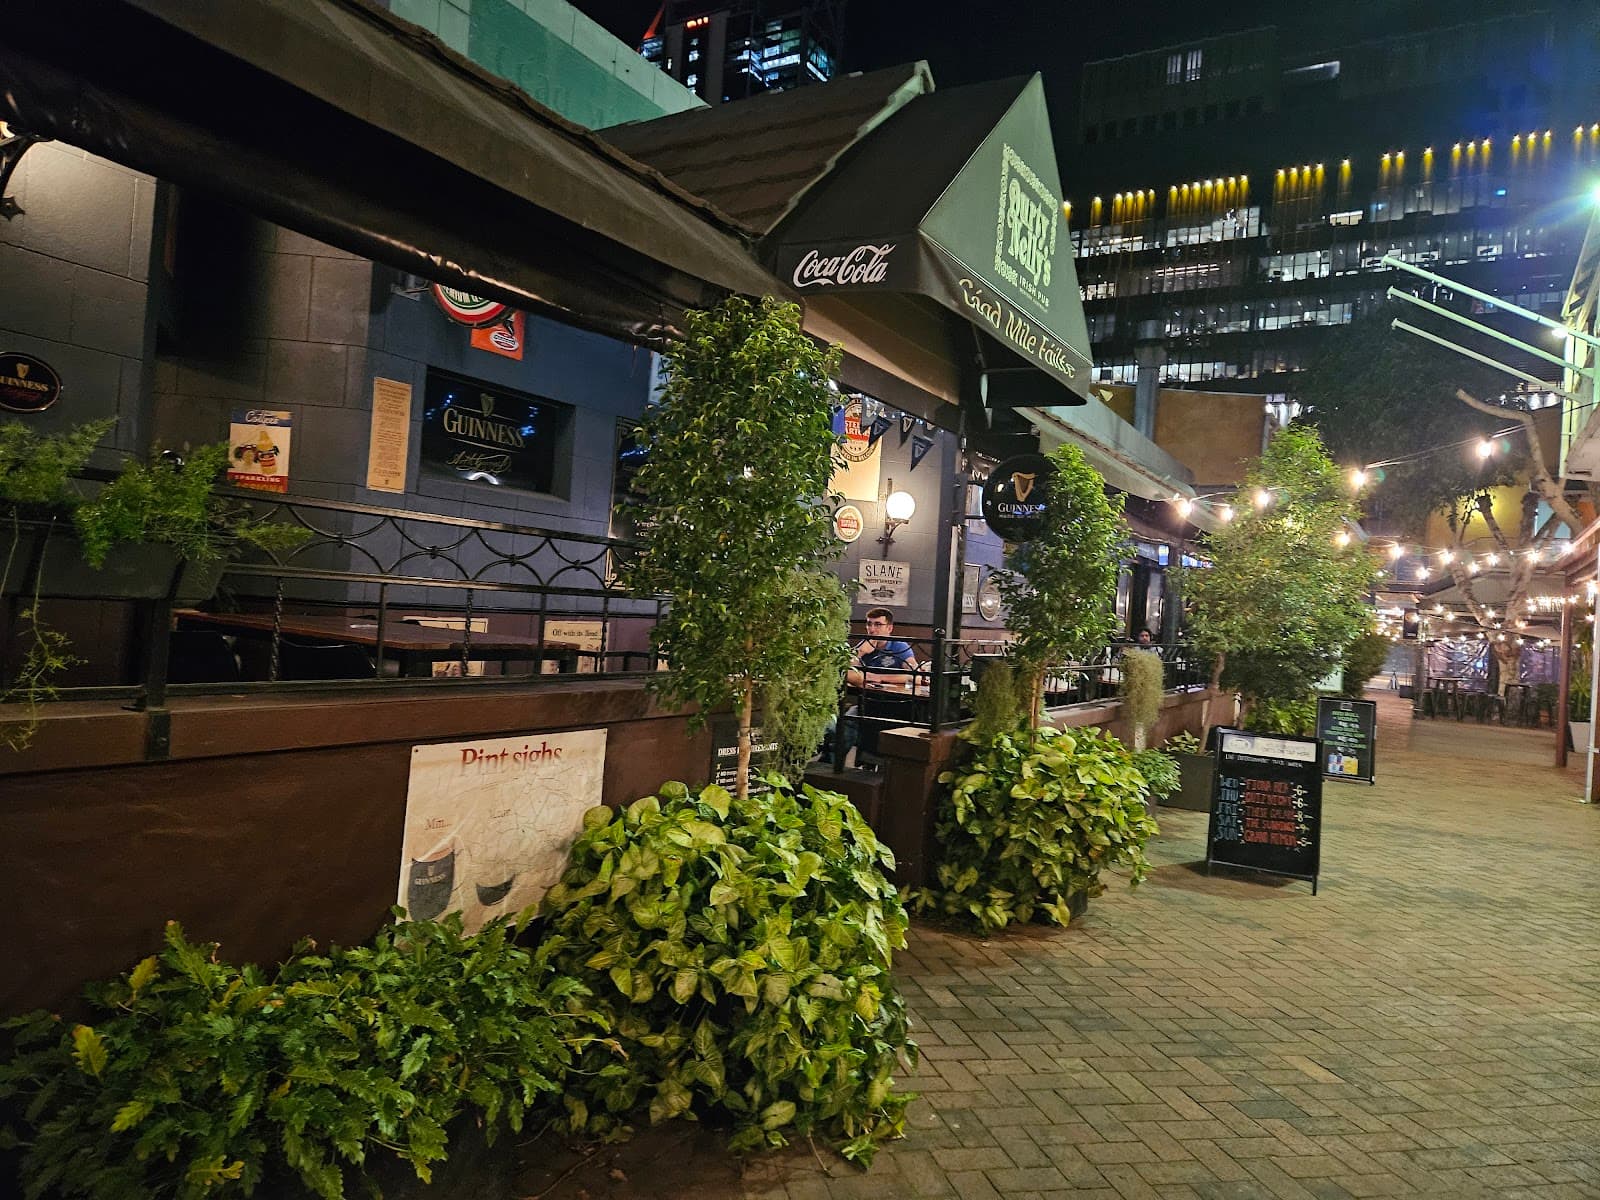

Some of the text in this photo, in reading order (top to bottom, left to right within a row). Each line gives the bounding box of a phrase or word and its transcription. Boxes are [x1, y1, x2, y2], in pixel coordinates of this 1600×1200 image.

[793, 244, 896, 288] Coca-Cola
[1020, 275, 1037, 297] IRISH
[1038, 291, 1049, 308] PUB
[865, 563, 903, 579] SLANE
[460, 741, 563, 777] Pint sighs
